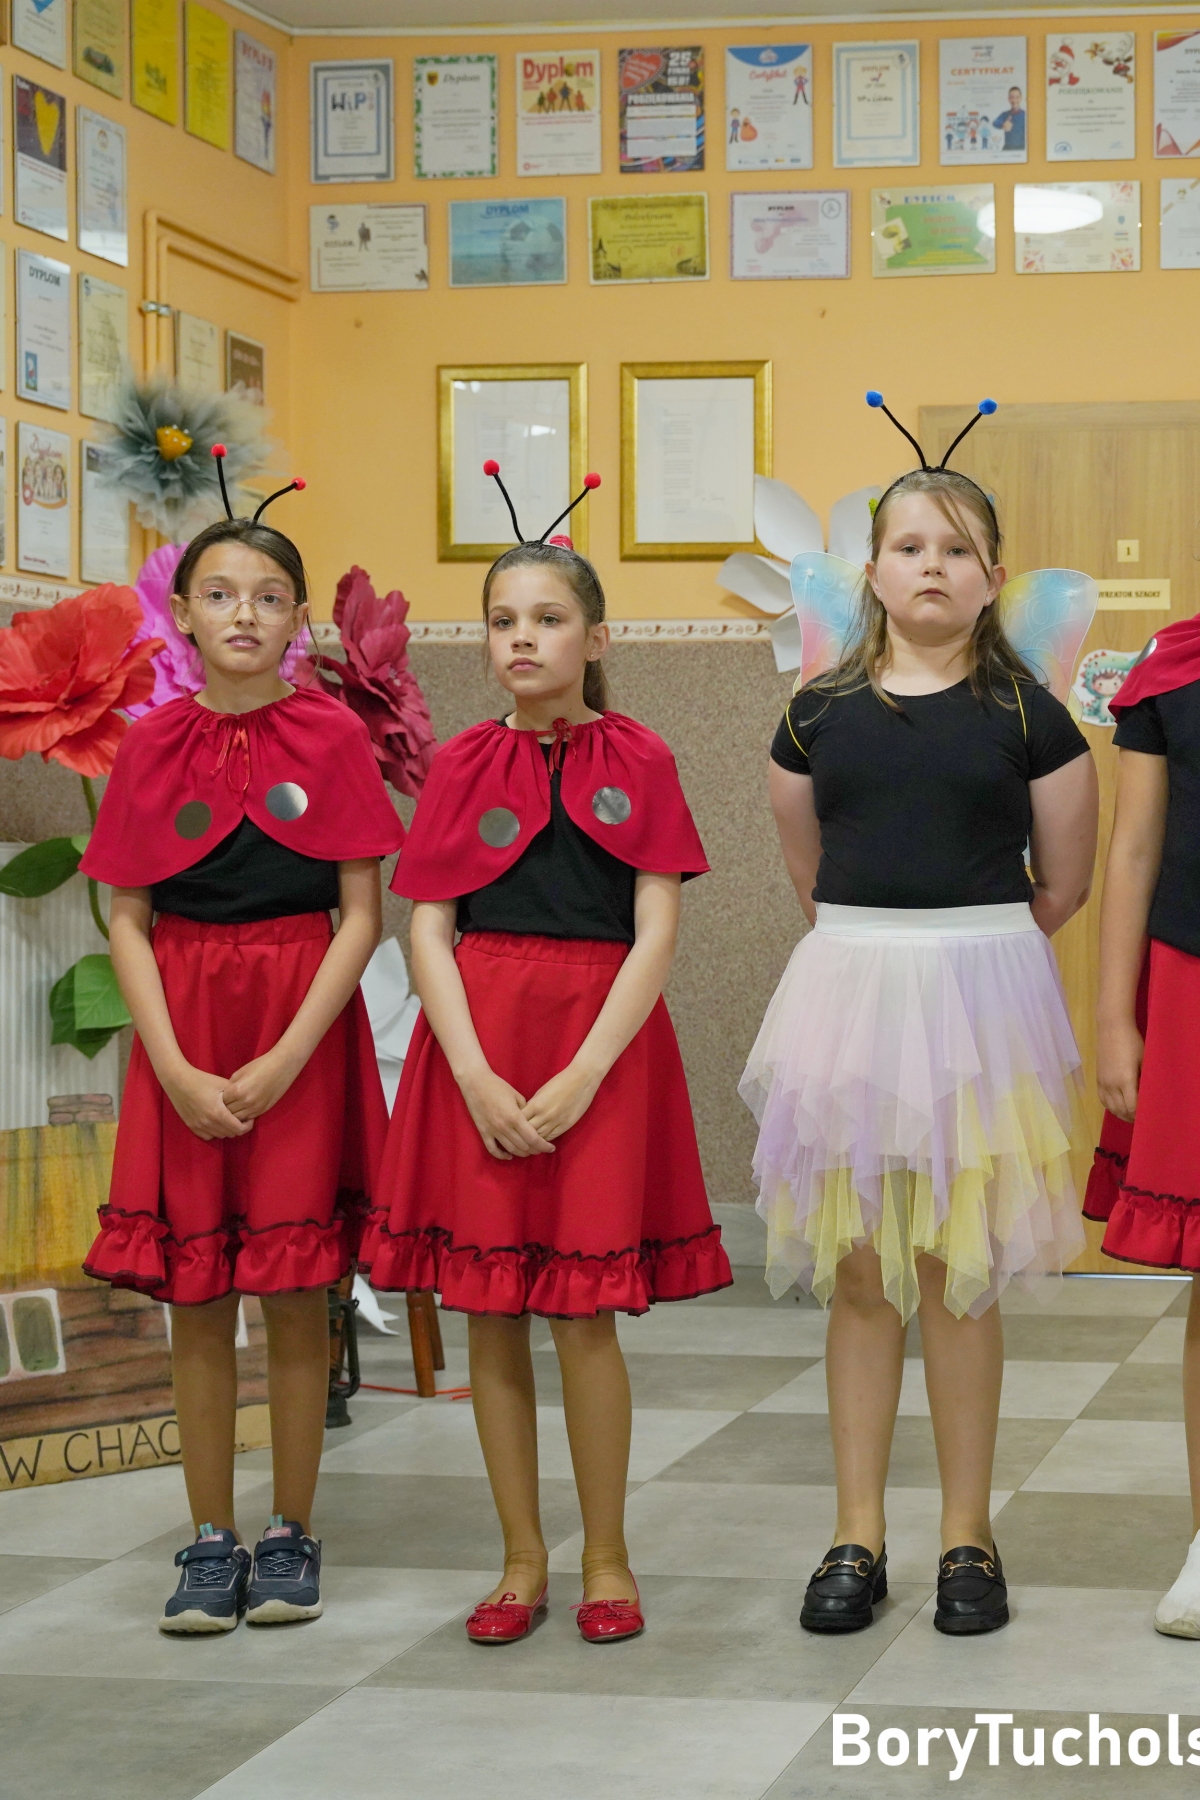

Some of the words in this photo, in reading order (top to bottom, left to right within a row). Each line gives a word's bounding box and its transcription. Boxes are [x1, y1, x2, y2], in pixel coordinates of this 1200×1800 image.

[523, 56, 594, 84] Dyplom
[669, 51, 692, 67] 25
[951, 66, 1015, 76] CERTYFIKAT
[486, 204, 529, 214] DYPLOM
[29, 265, 61, 287] DYPLOM
[30, 433, 62, 461] Dyplom
[0, 1439, 43, 1484] W
[64, 1419, 182, 1473] CHAC
